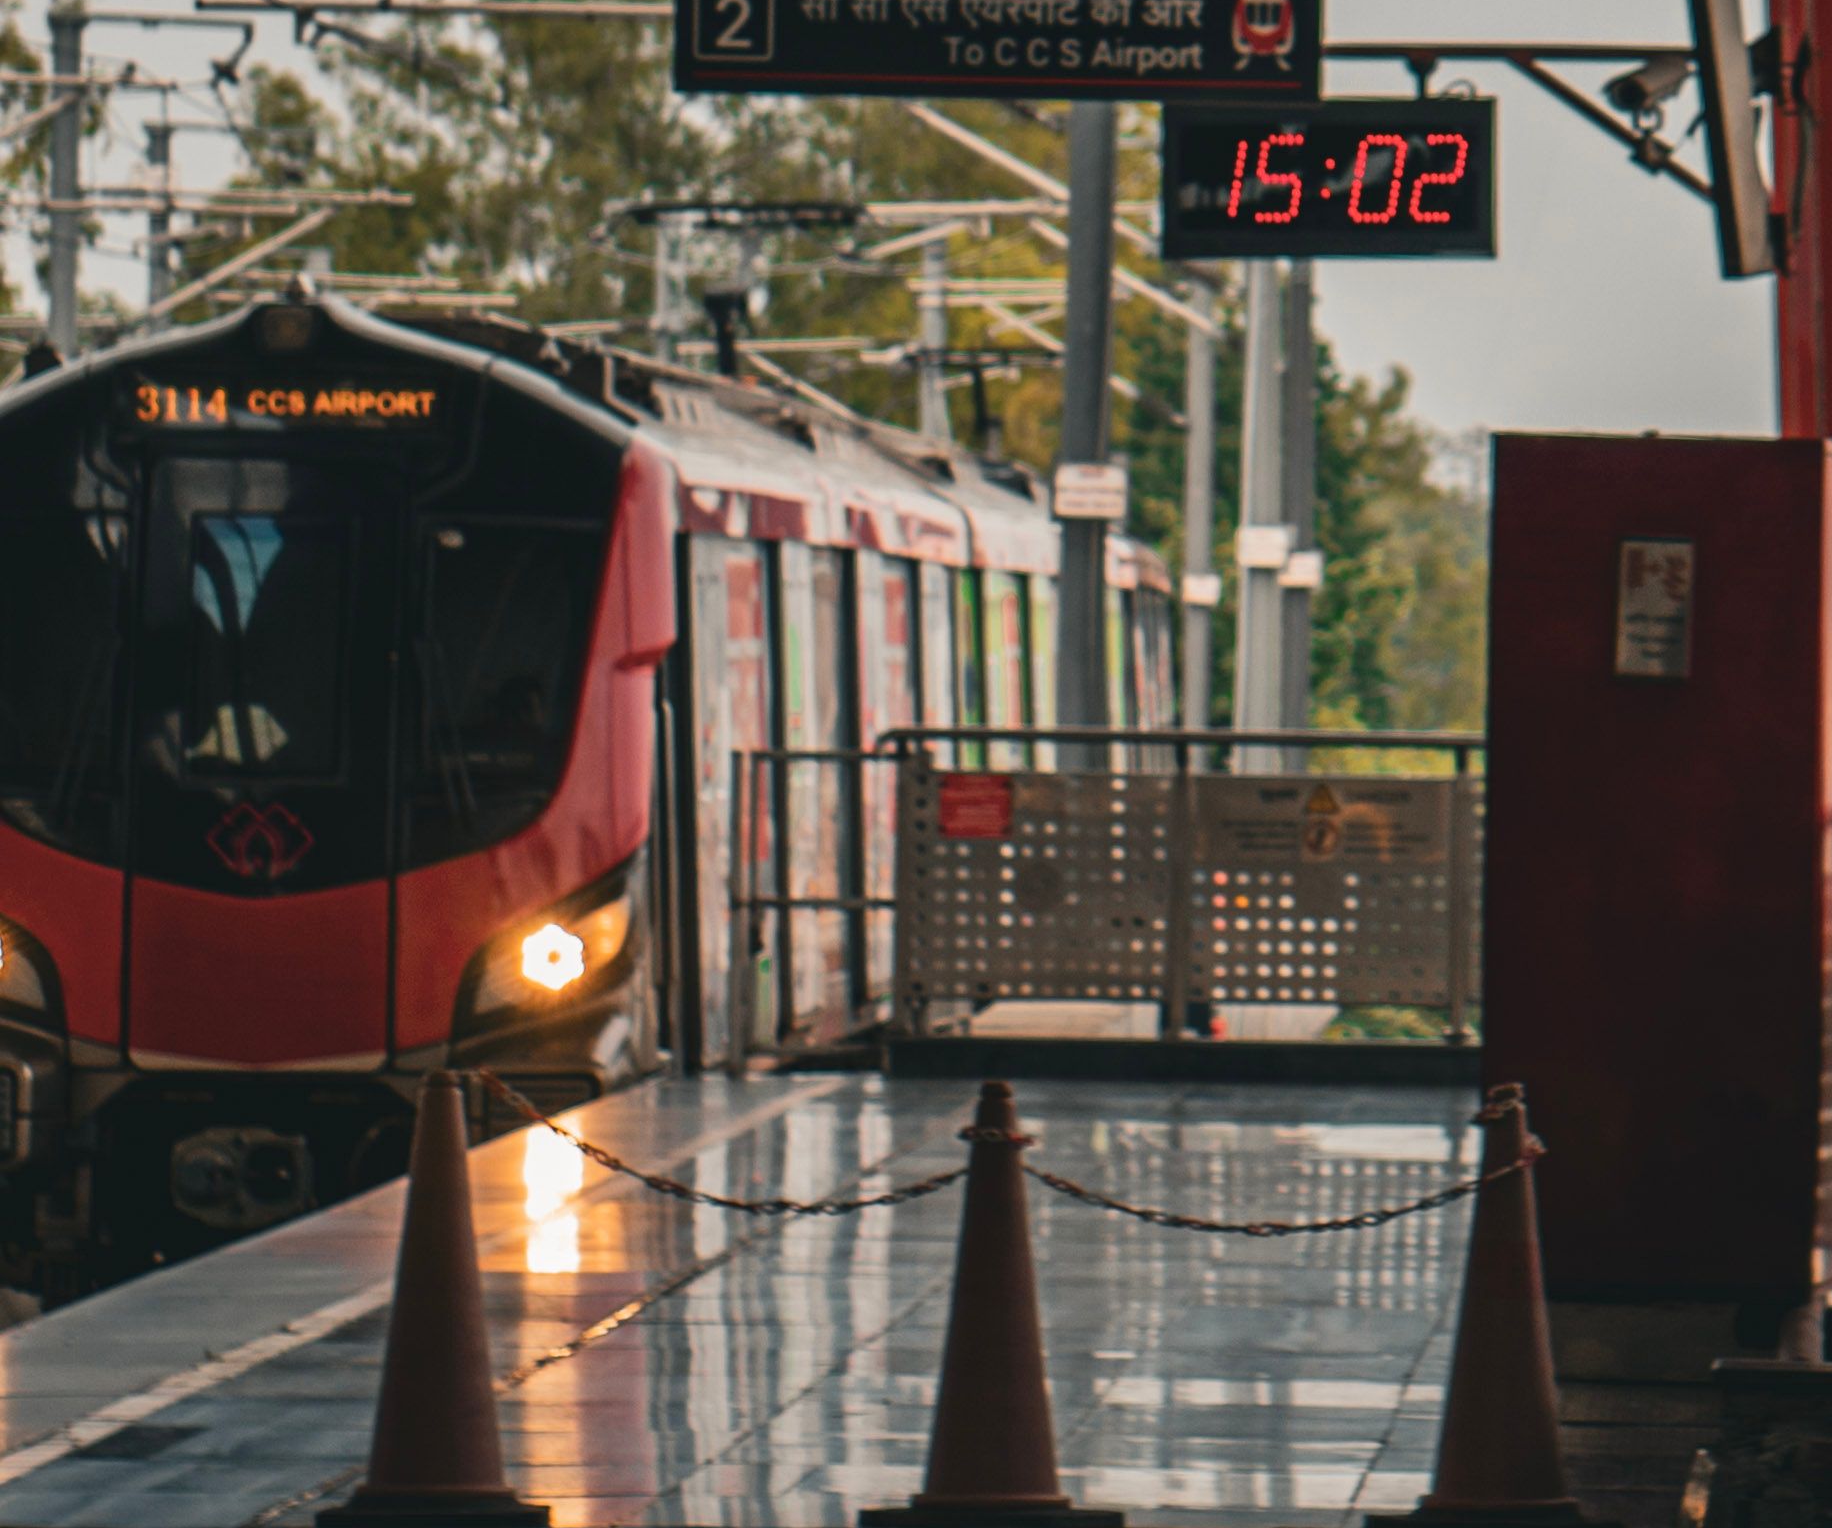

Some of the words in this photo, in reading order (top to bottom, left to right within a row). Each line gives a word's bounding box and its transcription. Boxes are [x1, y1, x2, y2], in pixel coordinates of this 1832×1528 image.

[944, 36, 985, 66] To
[994, 36, 1017, 67] C
[1026, 37, 1049, 68] C
[1059, 38, 1082, 69] S
[1090, 39, 1204, 77] Airport
[1226, 133, 1469, 224] 15:02
[135, 384, 229, 423] 3114
[247, 388, 306, 417] CCS
[312, 388, 436, 418] AIRPORT
